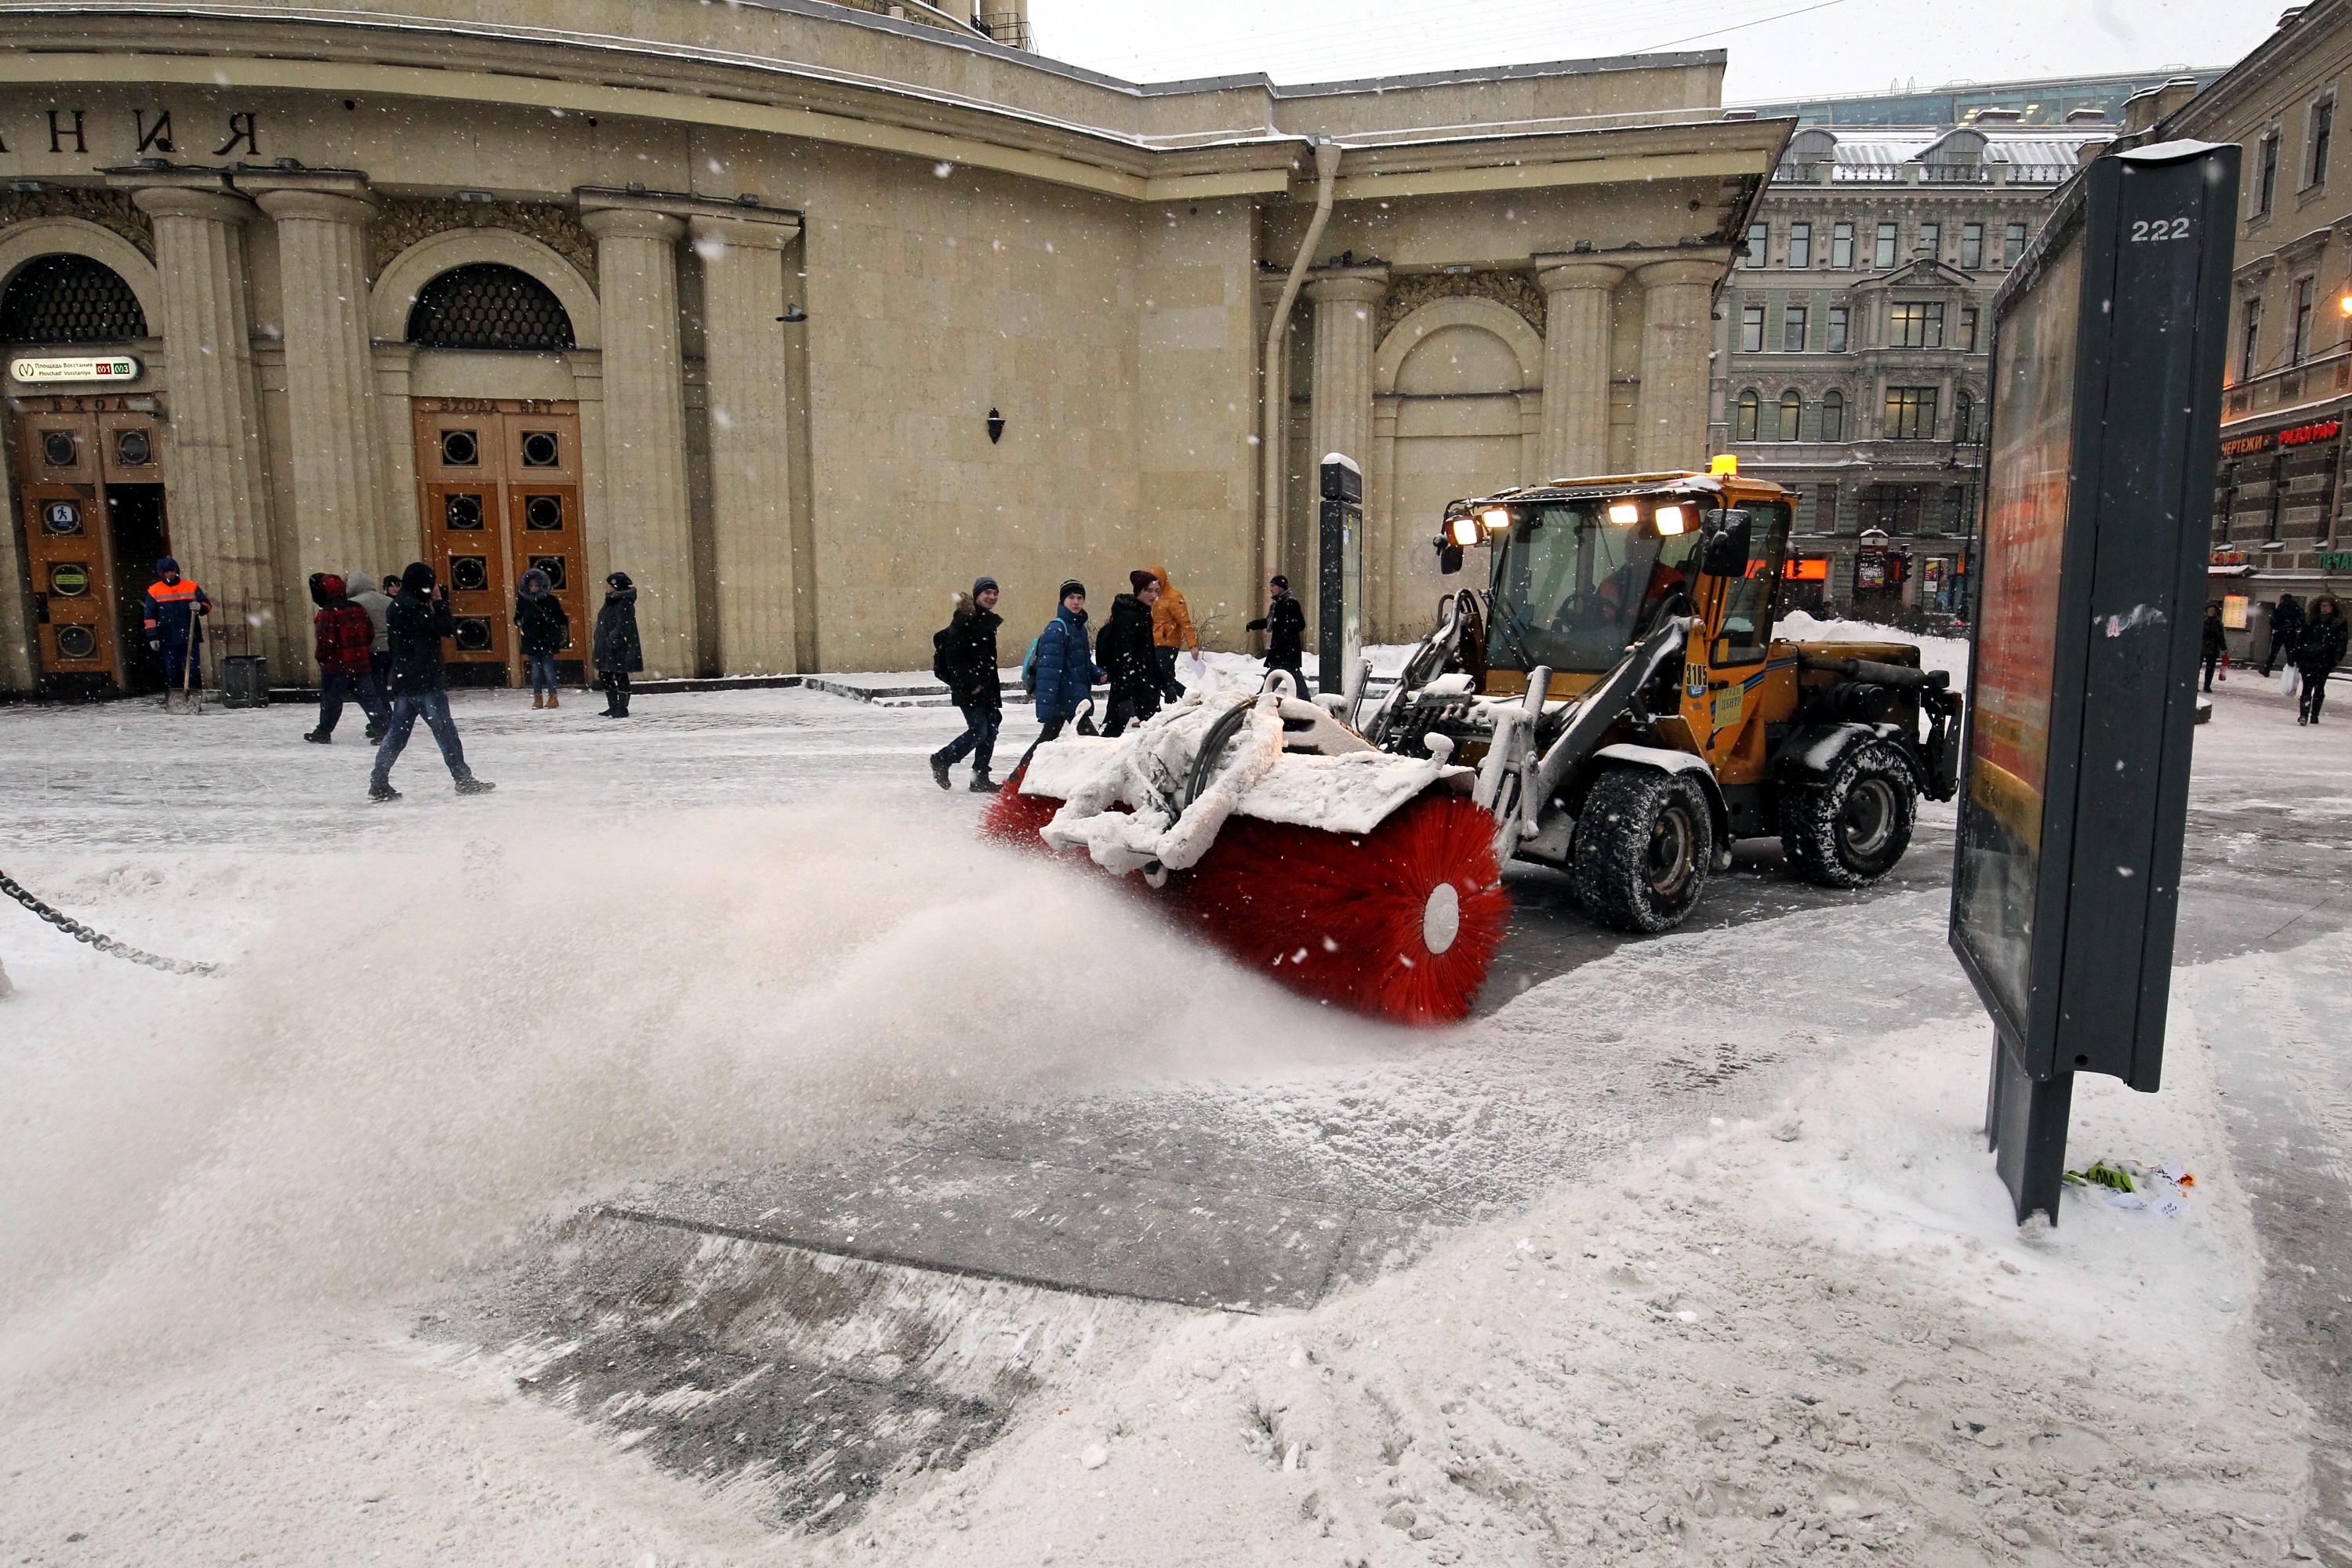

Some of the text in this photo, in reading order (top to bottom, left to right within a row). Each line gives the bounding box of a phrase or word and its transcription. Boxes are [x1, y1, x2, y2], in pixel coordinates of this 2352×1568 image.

[0, 109, 261, 155] НИЯ
[2131, 217, 2190, 241] 222
[53, 397, 129, 412] ВХОД
[440, 399, 554, 414] ВХОДА НЕТ
[2278, 420, 2339, 446] РИЗОГРАФ
[2222, 434, 2263, 456] ЧЕРТЕЖИ
[1686, 664, 1708, 686] 3185
[1721, 697, 1742, 710] ЦЕНТР
